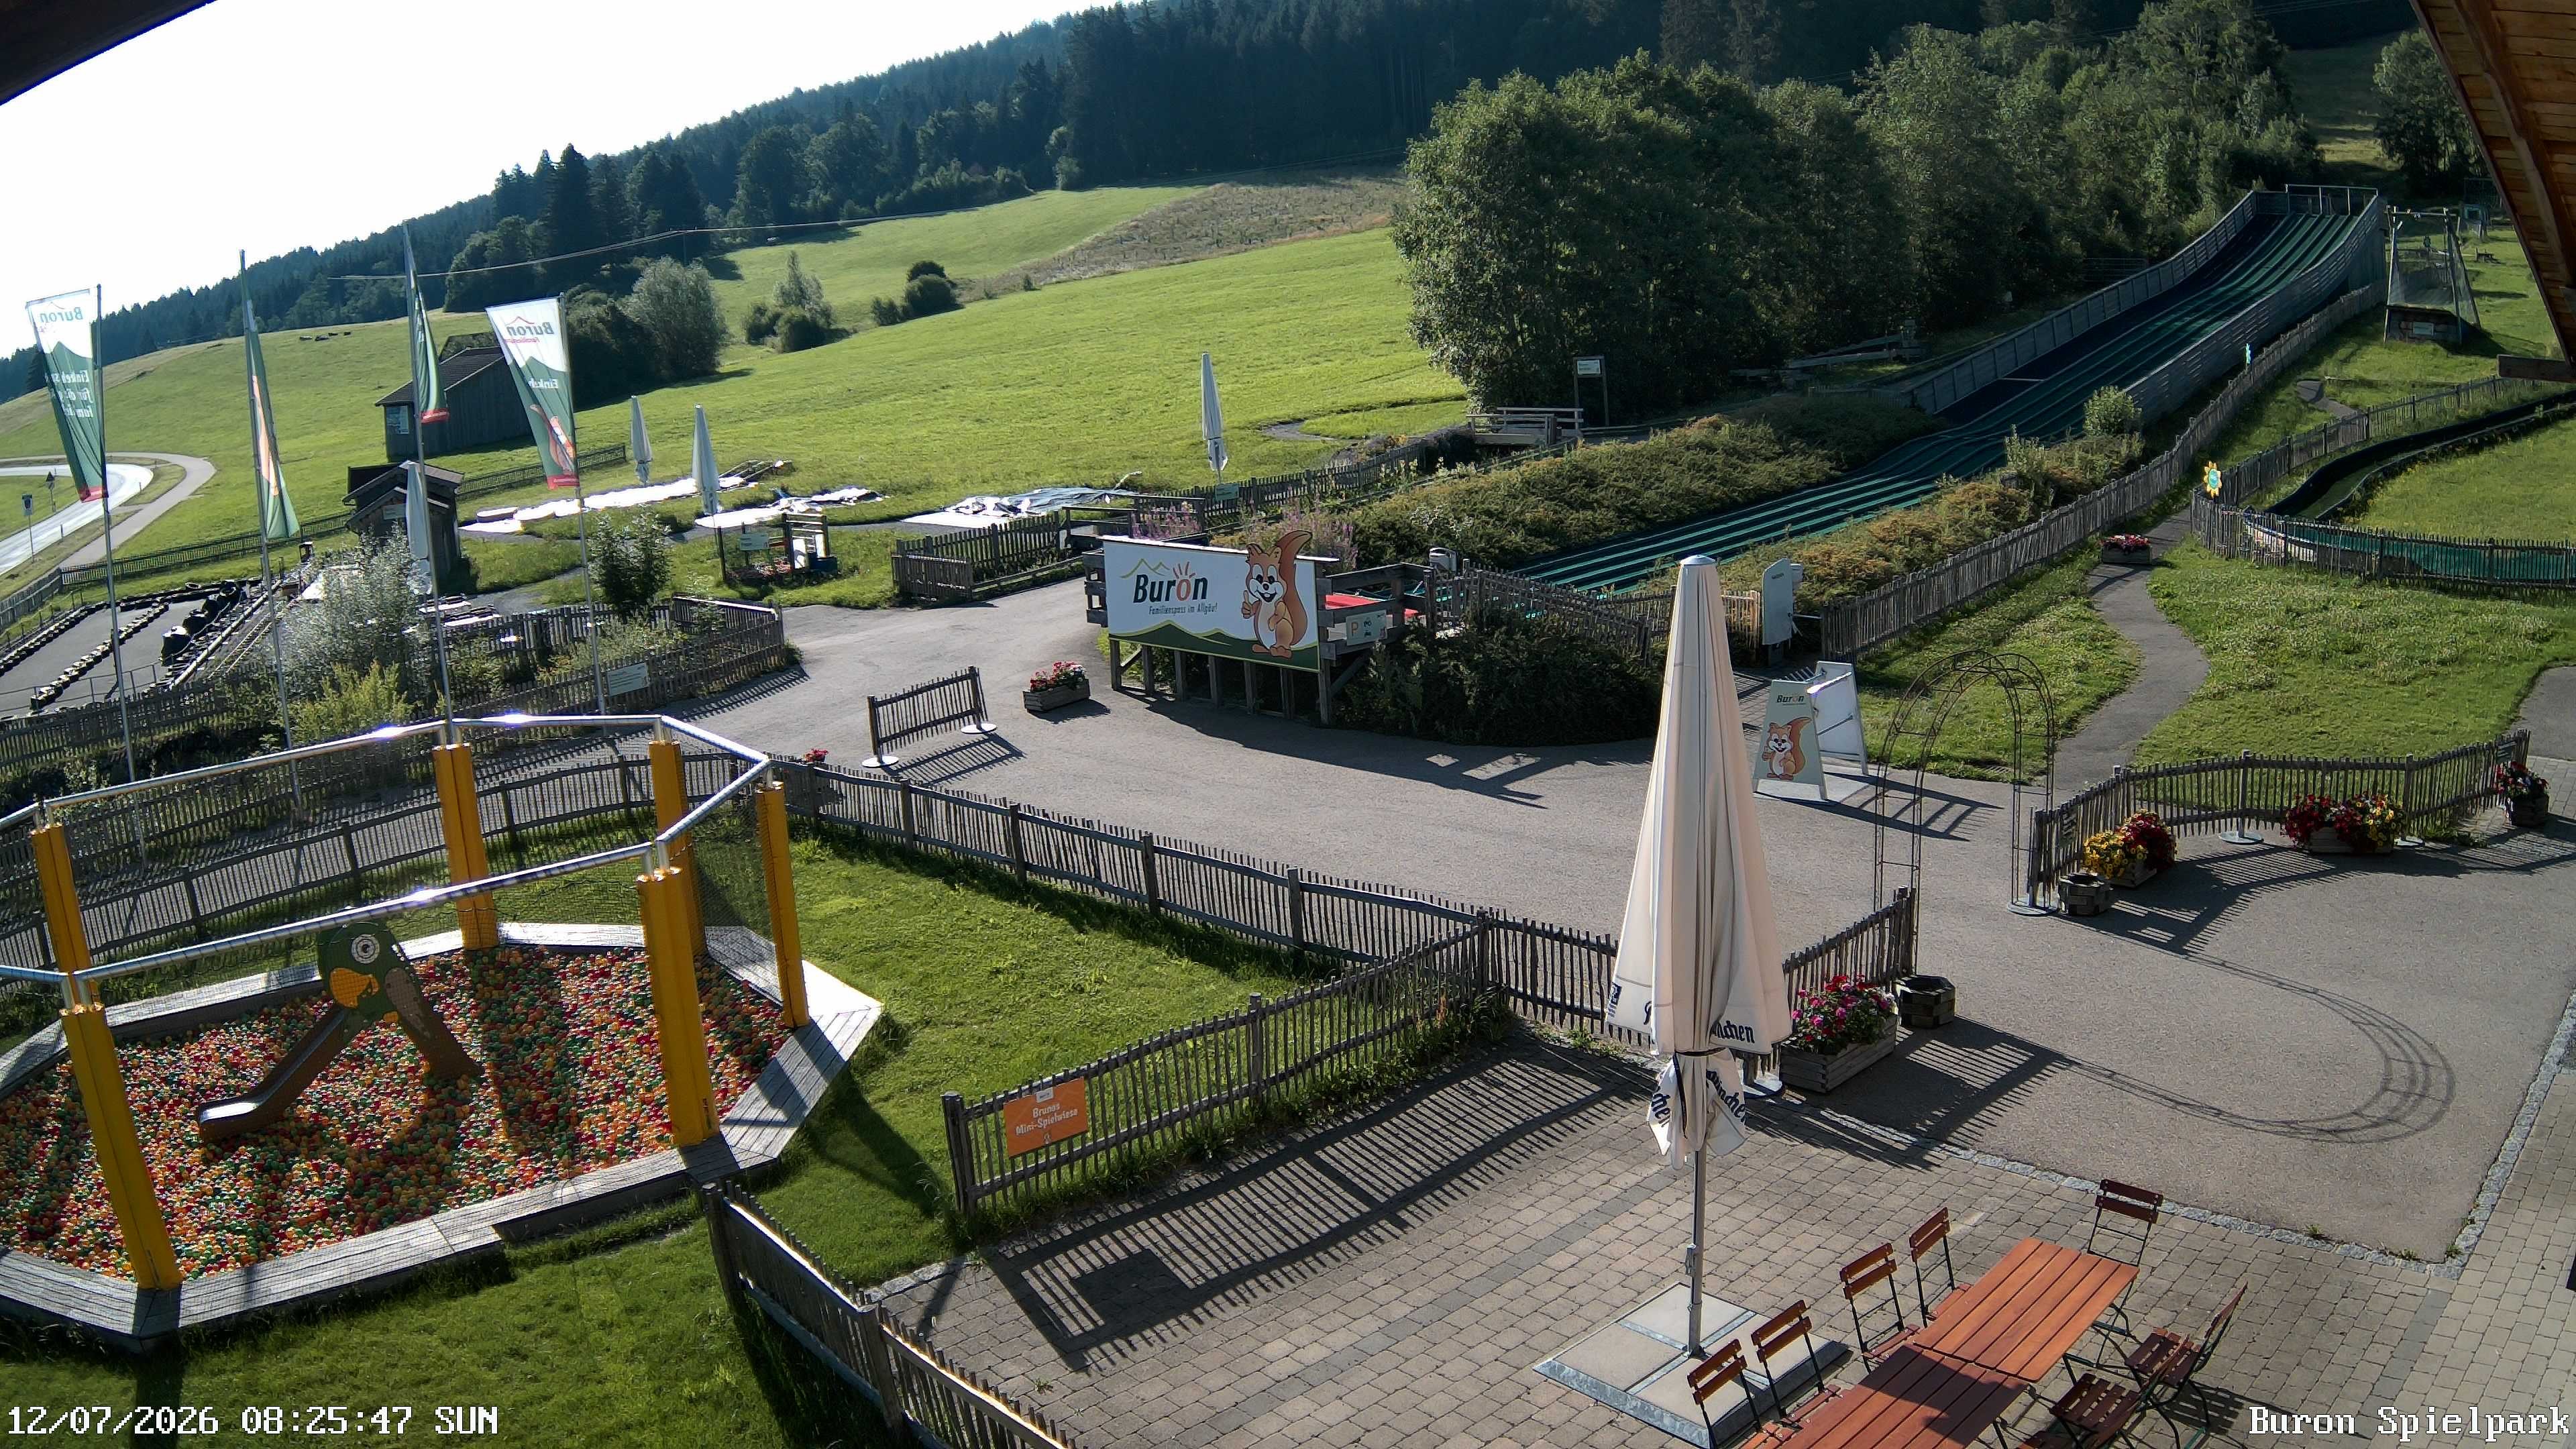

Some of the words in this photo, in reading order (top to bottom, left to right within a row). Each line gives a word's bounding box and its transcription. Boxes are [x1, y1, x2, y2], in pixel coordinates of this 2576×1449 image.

[1133, 574, 1208, 603] Buron
[1351, 621, 1358, 637] P
[1776, 694, 1805, 703] Buron
[1032, 1103, 1061, 1118] Brunos
